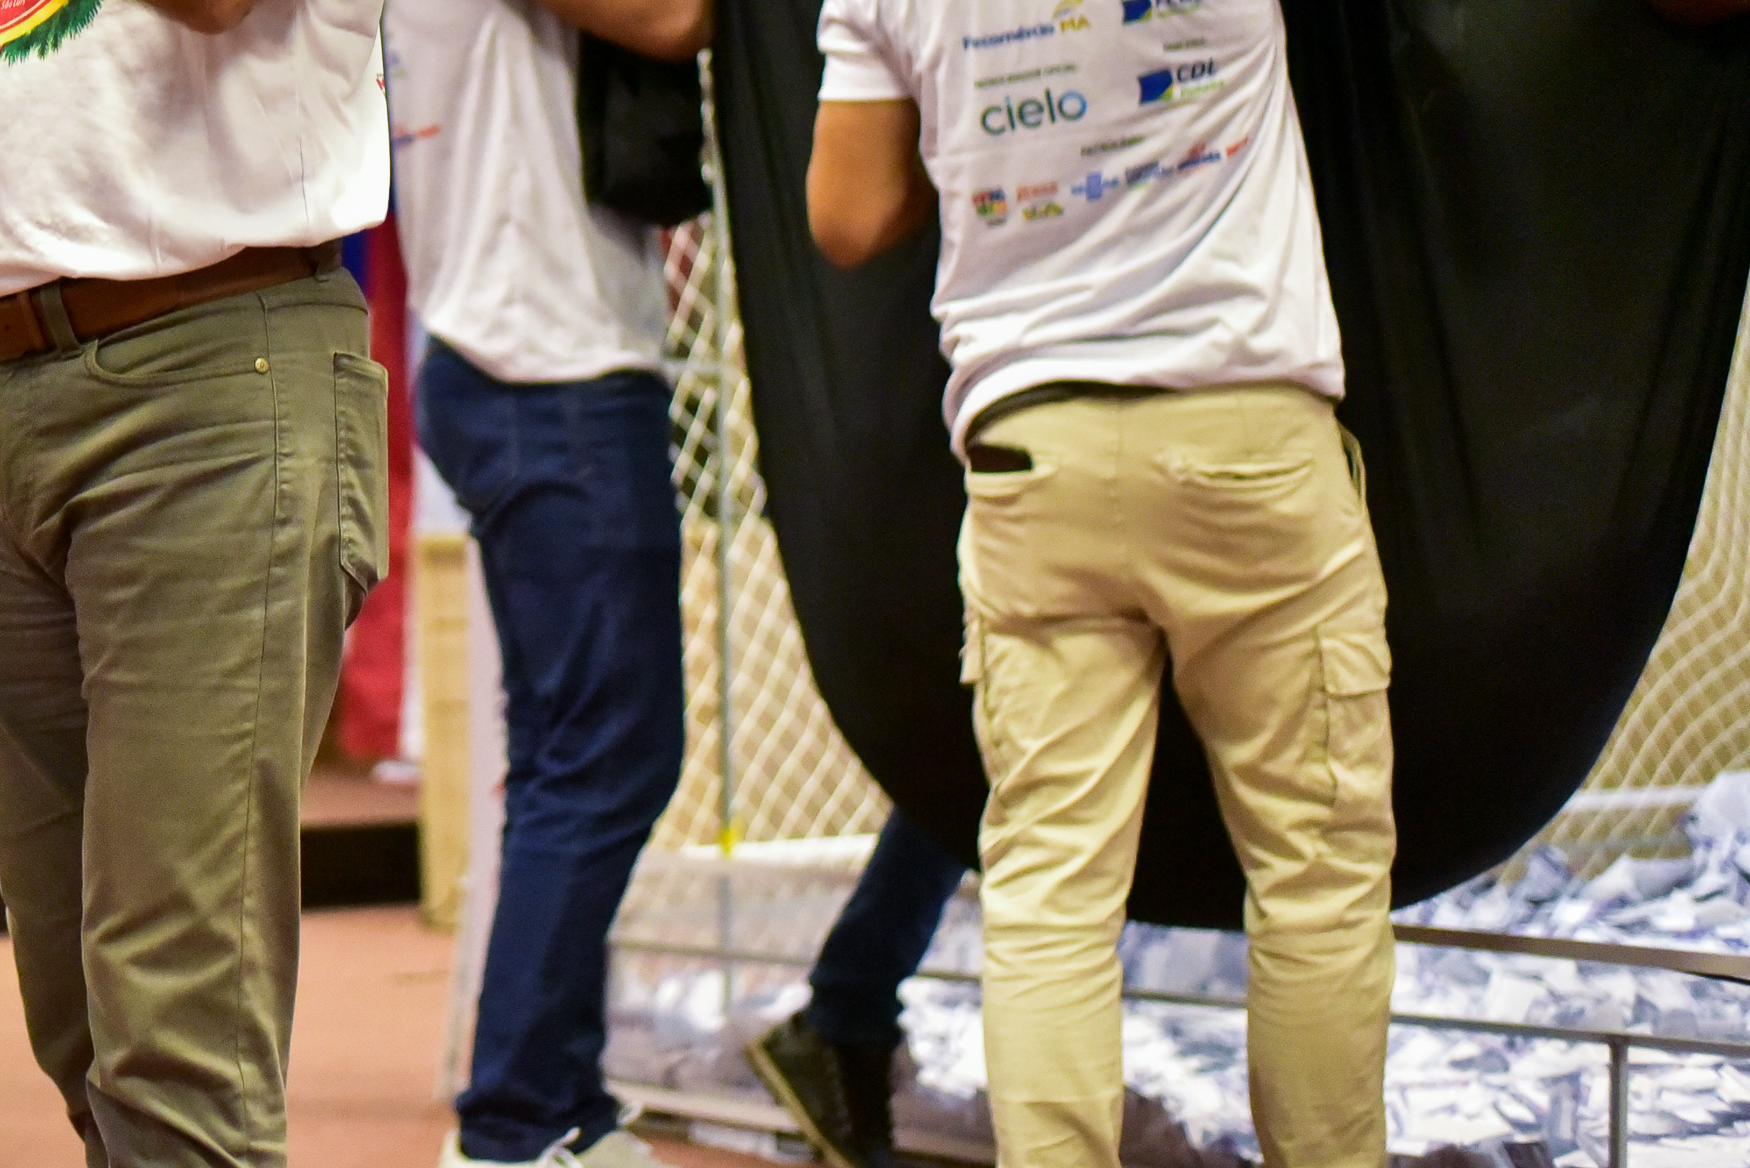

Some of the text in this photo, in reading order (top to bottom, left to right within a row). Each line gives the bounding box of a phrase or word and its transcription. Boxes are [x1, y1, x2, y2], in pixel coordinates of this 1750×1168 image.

[1, 0, 13, 10] São
[1176, 58, 1216, 83] CDL
[980, 87, 1088, 135] cielo
